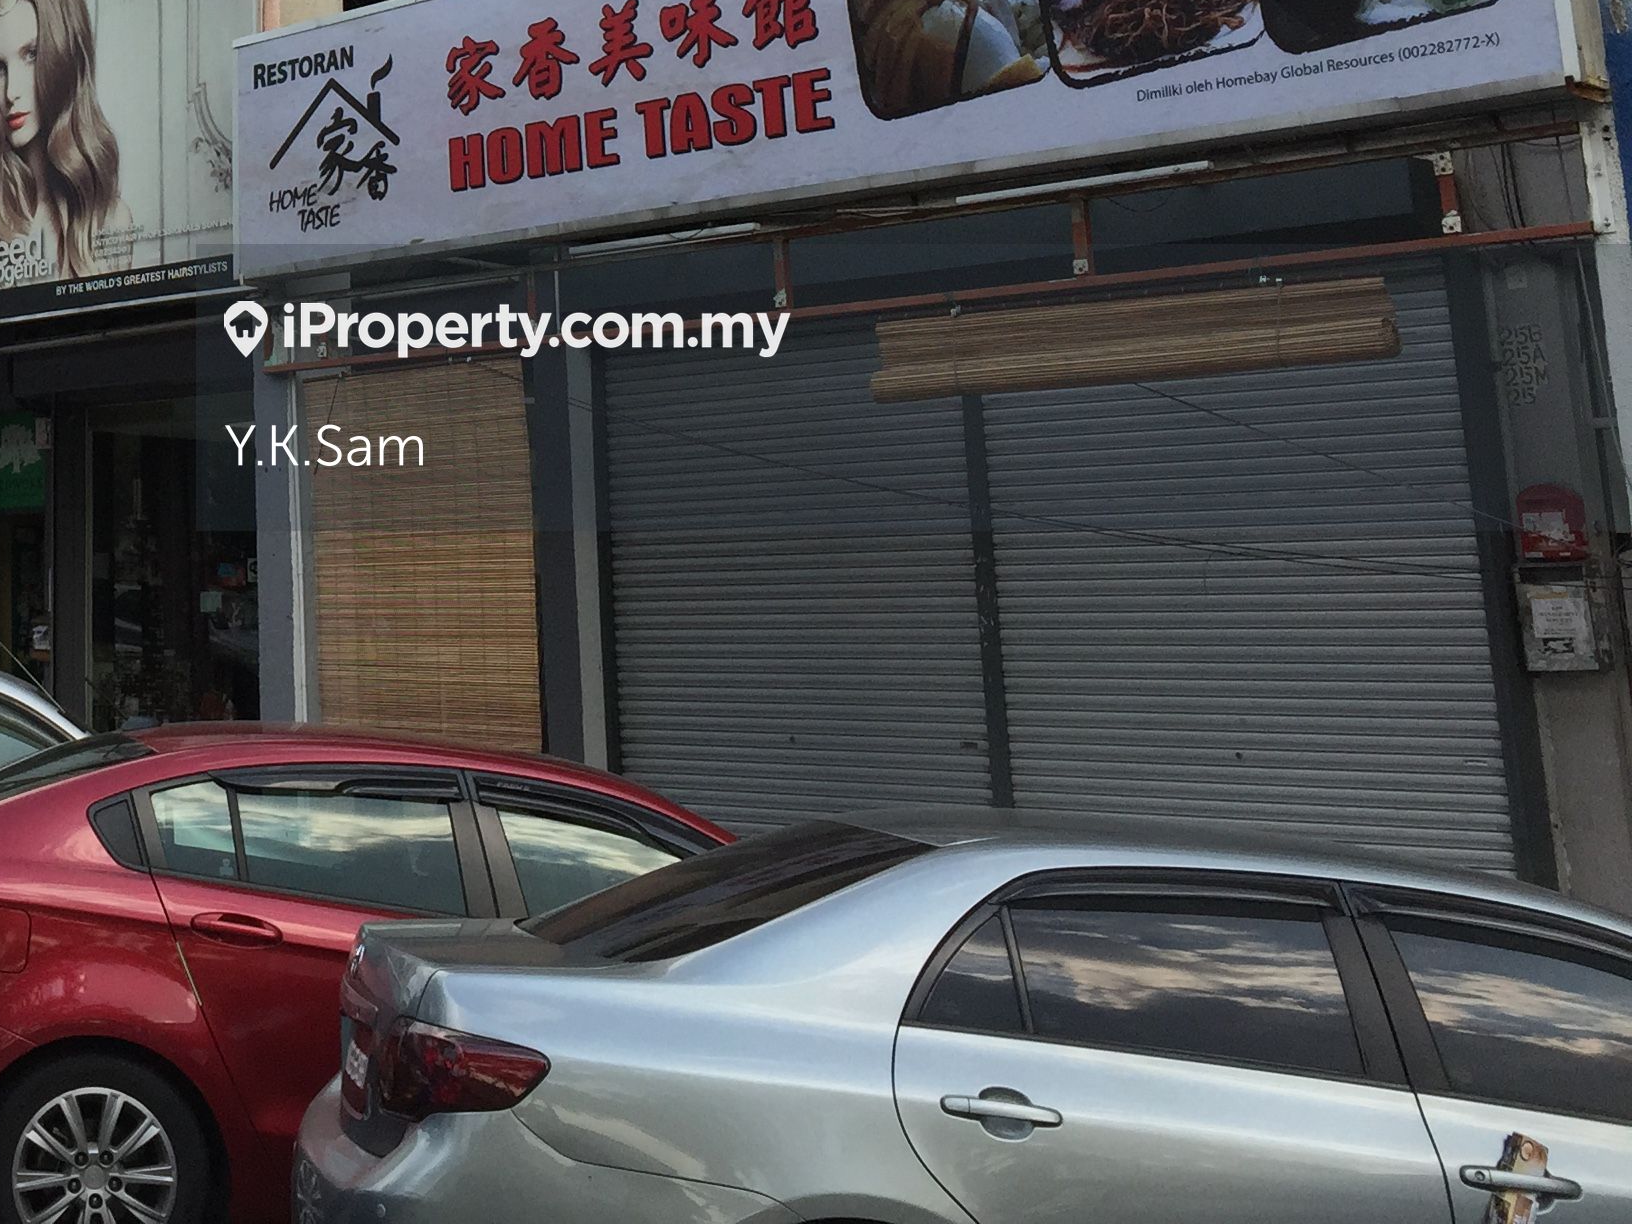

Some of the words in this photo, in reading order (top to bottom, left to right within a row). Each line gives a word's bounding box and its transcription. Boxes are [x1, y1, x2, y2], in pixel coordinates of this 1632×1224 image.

[253, 45, 354, 90] RESTORAN
[1185, 79, 1213, 94] oleh
[1216, 66, 1278, 90] Homebay
[1280, 60, 1324, 80] Global
[1327, 50, 1395, 73] Resources
[1398, 31, 1501, 63] (002282772-X)
[448, 107, 621, 193] HOME
[634, 67, 836, 160] TASTE
[269, 183, 318, 213] HOME
[297, 204, 341, 232] TASTE
[55, 284, 67, 296] BY
[68, 281, 85, 294] THE
[86, 276, 123, 292] WORLD'S
[124, 269, 166, 286] GREATEST
[167, 260, 228, 280] HAIRSTYLISTS
